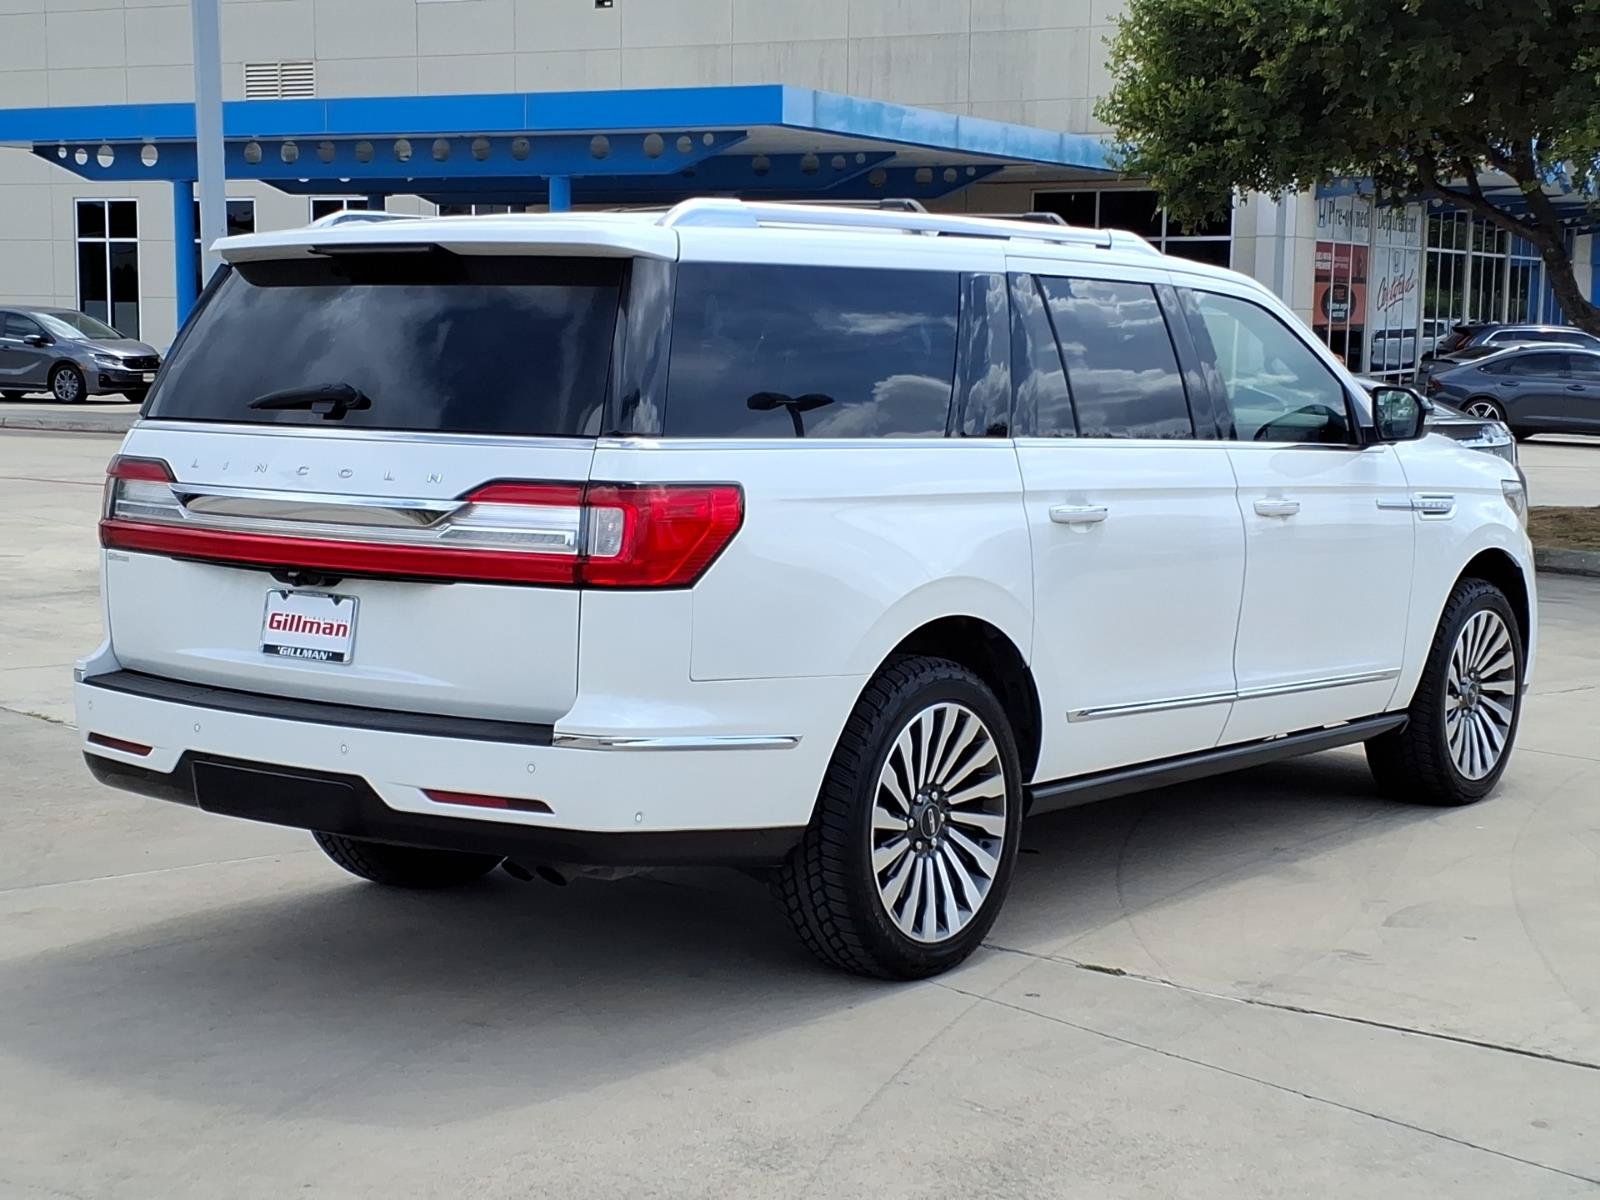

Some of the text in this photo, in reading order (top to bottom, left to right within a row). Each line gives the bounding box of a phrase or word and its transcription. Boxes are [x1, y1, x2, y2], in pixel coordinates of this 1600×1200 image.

[1328, 200, 1370, 228] Pre-oned
[191, 457, 443, 484] LINCOLN
[268, 612, 348, 637] Gillman
